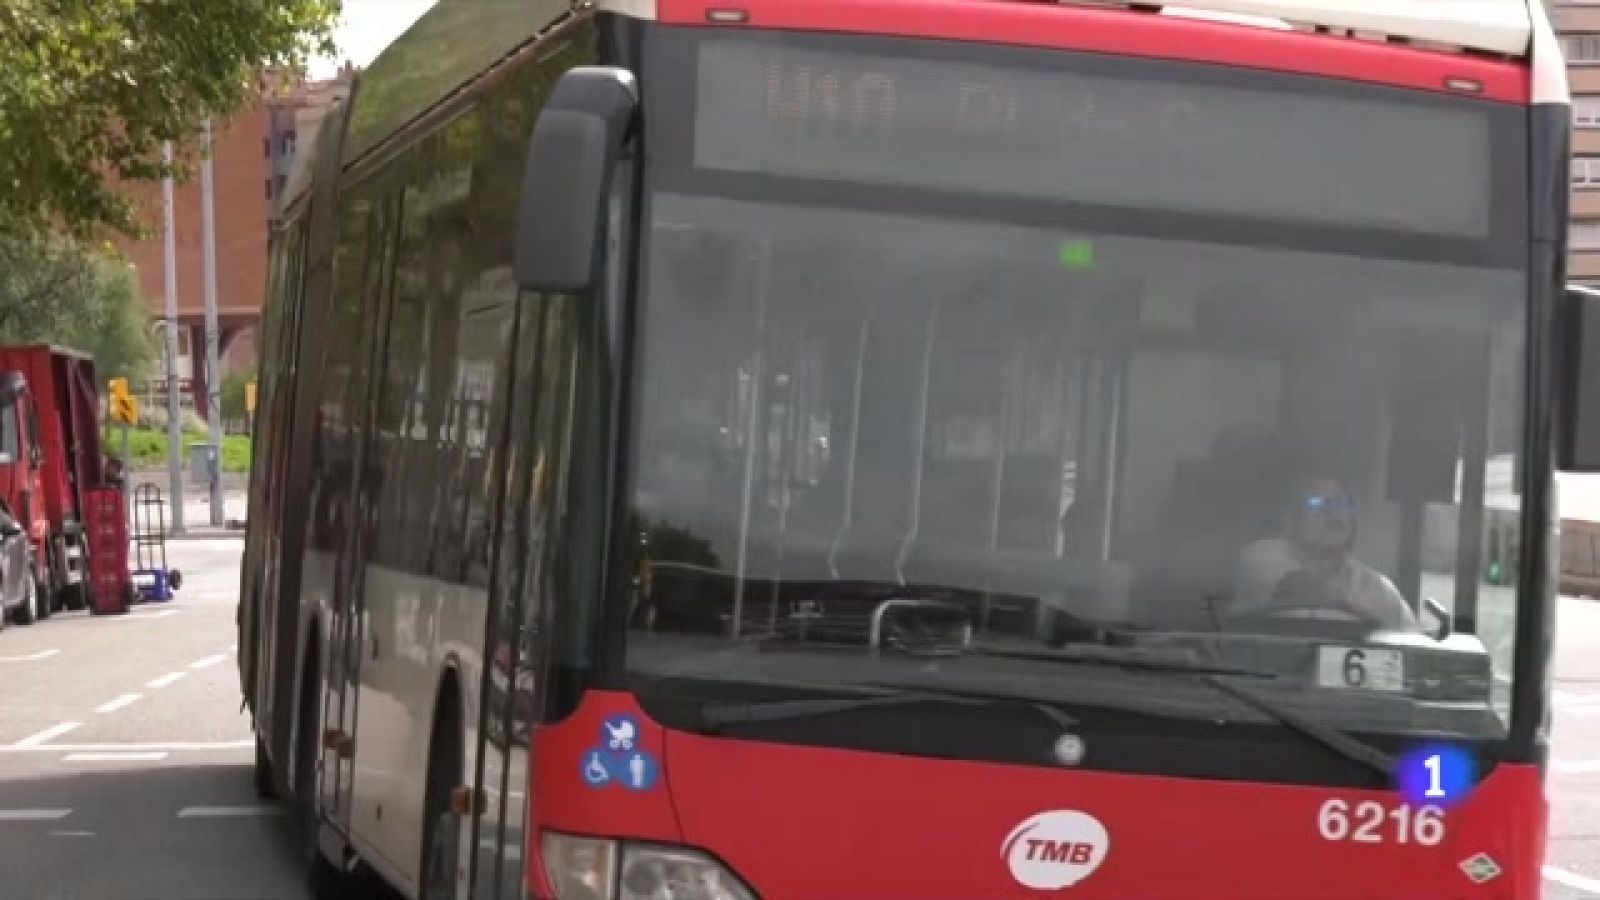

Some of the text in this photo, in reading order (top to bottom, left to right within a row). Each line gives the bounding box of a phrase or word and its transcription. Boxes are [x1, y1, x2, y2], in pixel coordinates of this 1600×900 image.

[1343, 649, 1367, 687] 6
[1318, 798, 1445, 846] 6216
[1025, 838, 1095, 866] TMB
